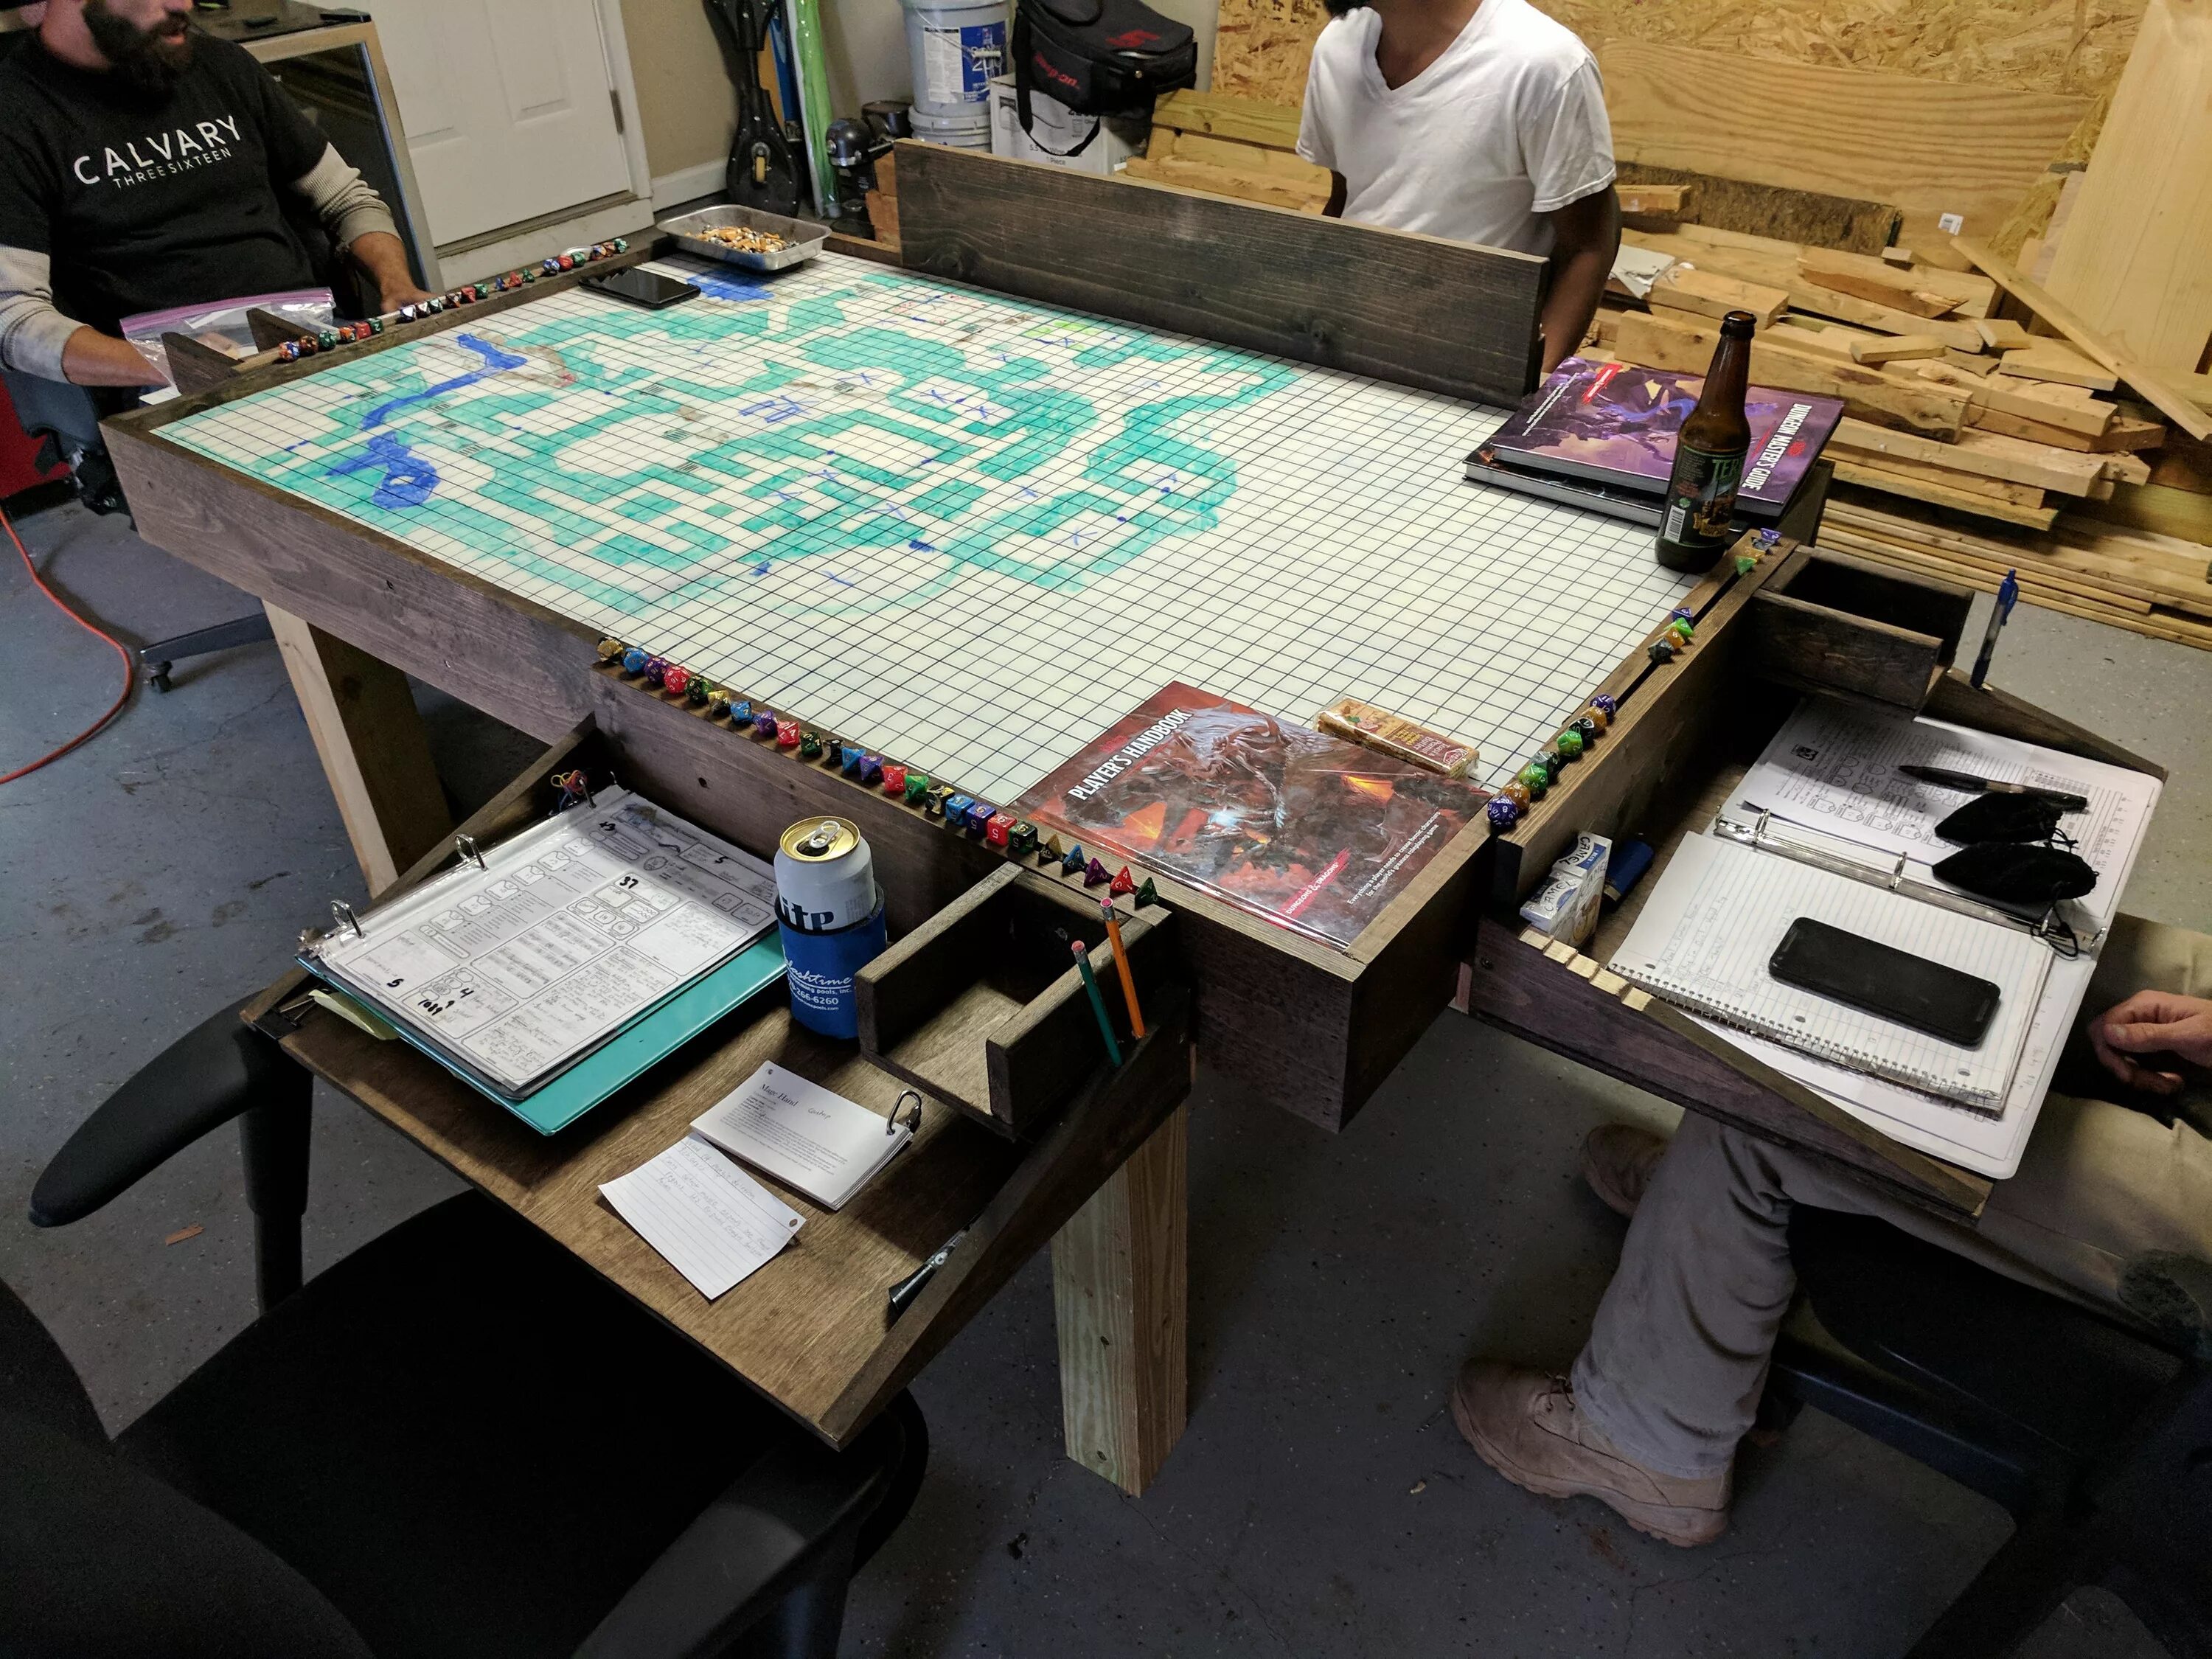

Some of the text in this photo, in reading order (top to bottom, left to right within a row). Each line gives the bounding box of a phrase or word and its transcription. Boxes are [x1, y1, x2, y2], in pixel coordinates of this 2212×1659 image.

[74, 115, 241, 184] CALVARY
[1777, 403, 1812, 435] DUNGEON
[1756, 434, 1793, 468] MASTER'S
[1742, 467, 1771, 491] GUIDE
[1068, 709, 1194, 801] PLAYER'S HANDBOOK
[1413, 737, 1433, 750] Butter
[1421, 740, 1442, 754] Peanut
[1433, 743, 1451, 756] Toast
[1502, 805, 1509, 813] 8
[1346, 880, 1371, 906] Everything
[1371, 866, 1386, 882] player
[1382, 855, 1397, 869] needs
[1398, 839, 1412, 854] create
[1419, 810, 1441, 831] characters
[1366, 823, 1439, 897] for the world's greatest roleplaying game
[1559, 836, 1590, 865] CAMEL
[619, 876, 639, 889] 37
[1285, 888, 1313, 914] DUNGEONS
[1317, 863, 1339, 885] DRAGONS
[1543, 881, 1576, 912] CAMEL
[816, 987, 838, 995] pools,
[417, 998, 444, 1016] 1089
[759, 1083, 779, 1097] Mage
[777, 1092, 799, 1107] Hand
